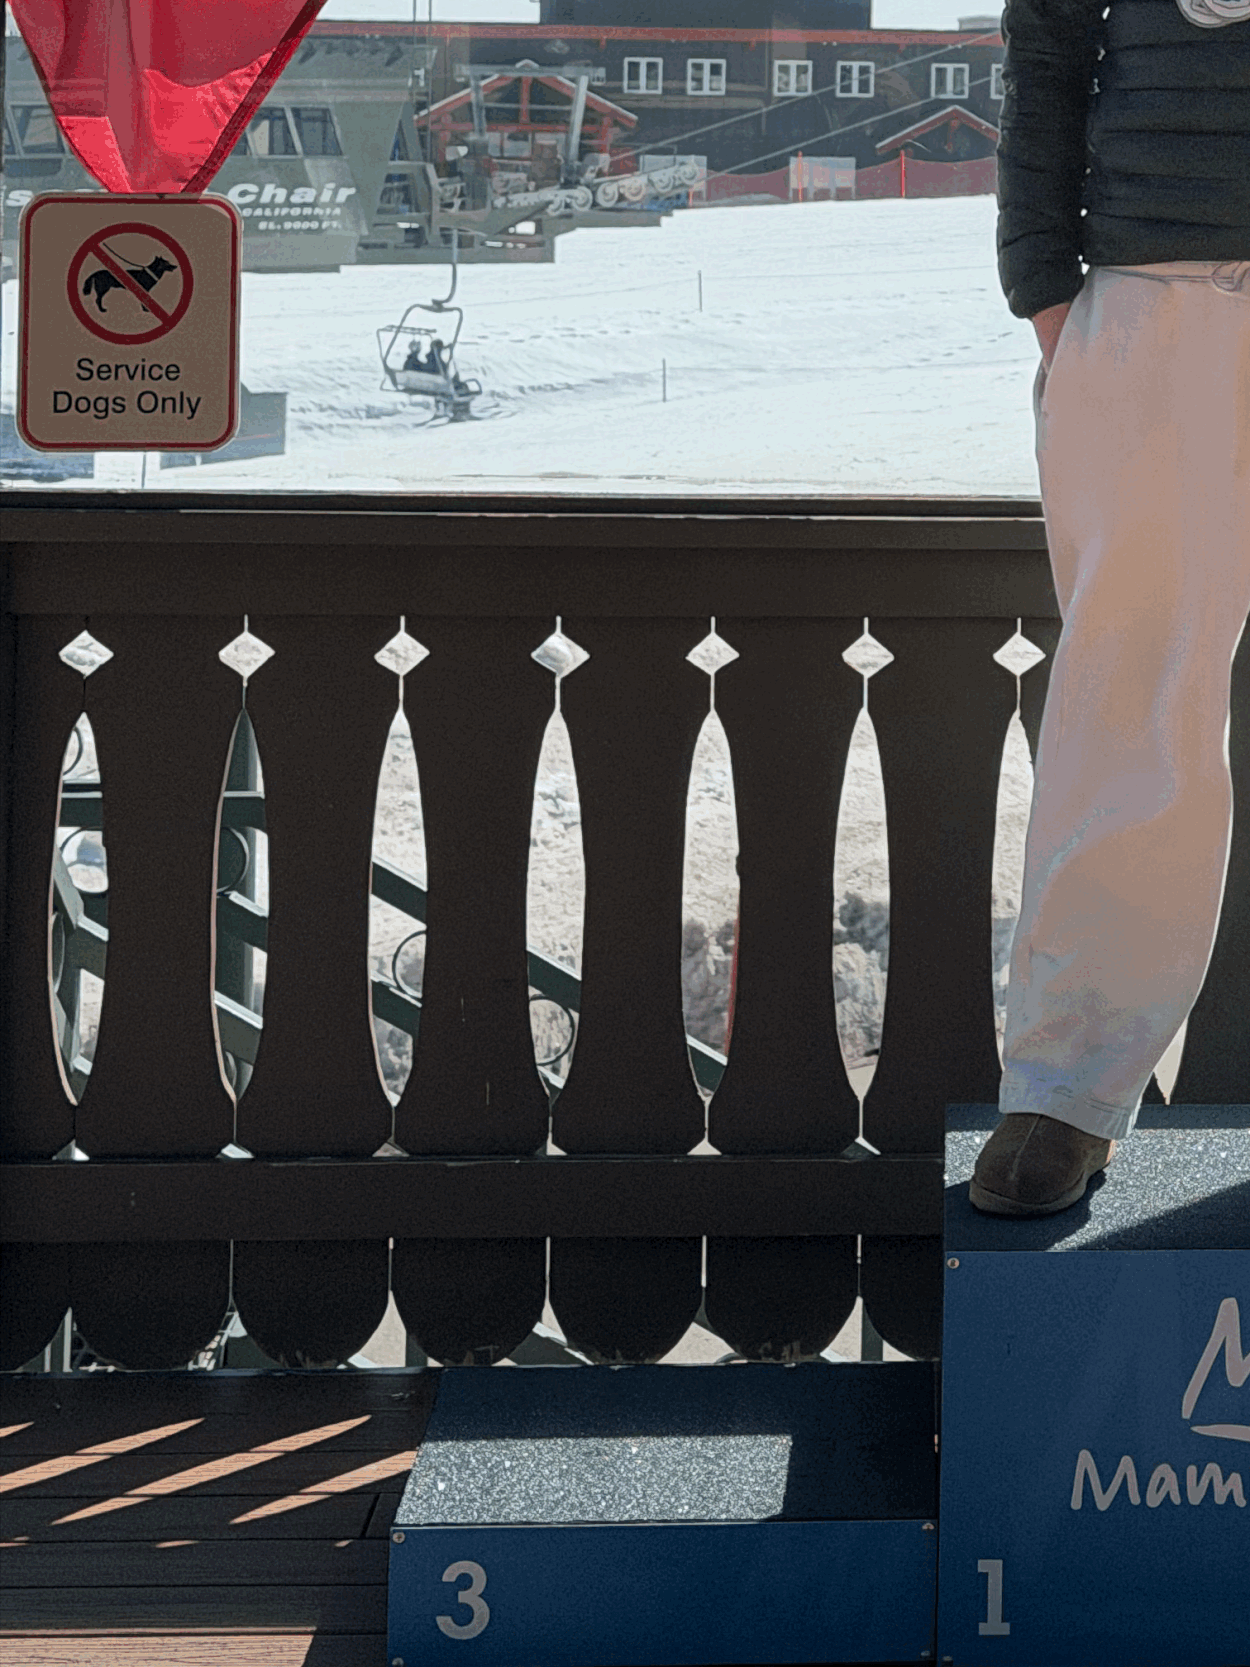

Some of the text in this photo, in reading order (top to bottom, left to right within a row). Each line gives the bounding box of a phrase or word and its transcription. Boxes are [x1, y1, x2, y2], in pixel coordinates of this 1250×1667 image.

[227, 182, 357, 204] Chair
[241, 207, 341, 217] CALIFORNIA
[75, 358, 182, 382] Service
[52, 390, 202, 421] Dogs Only
[435, 1560, 491, 1641] 3
[977, 1559, 1011, 1636] 1
